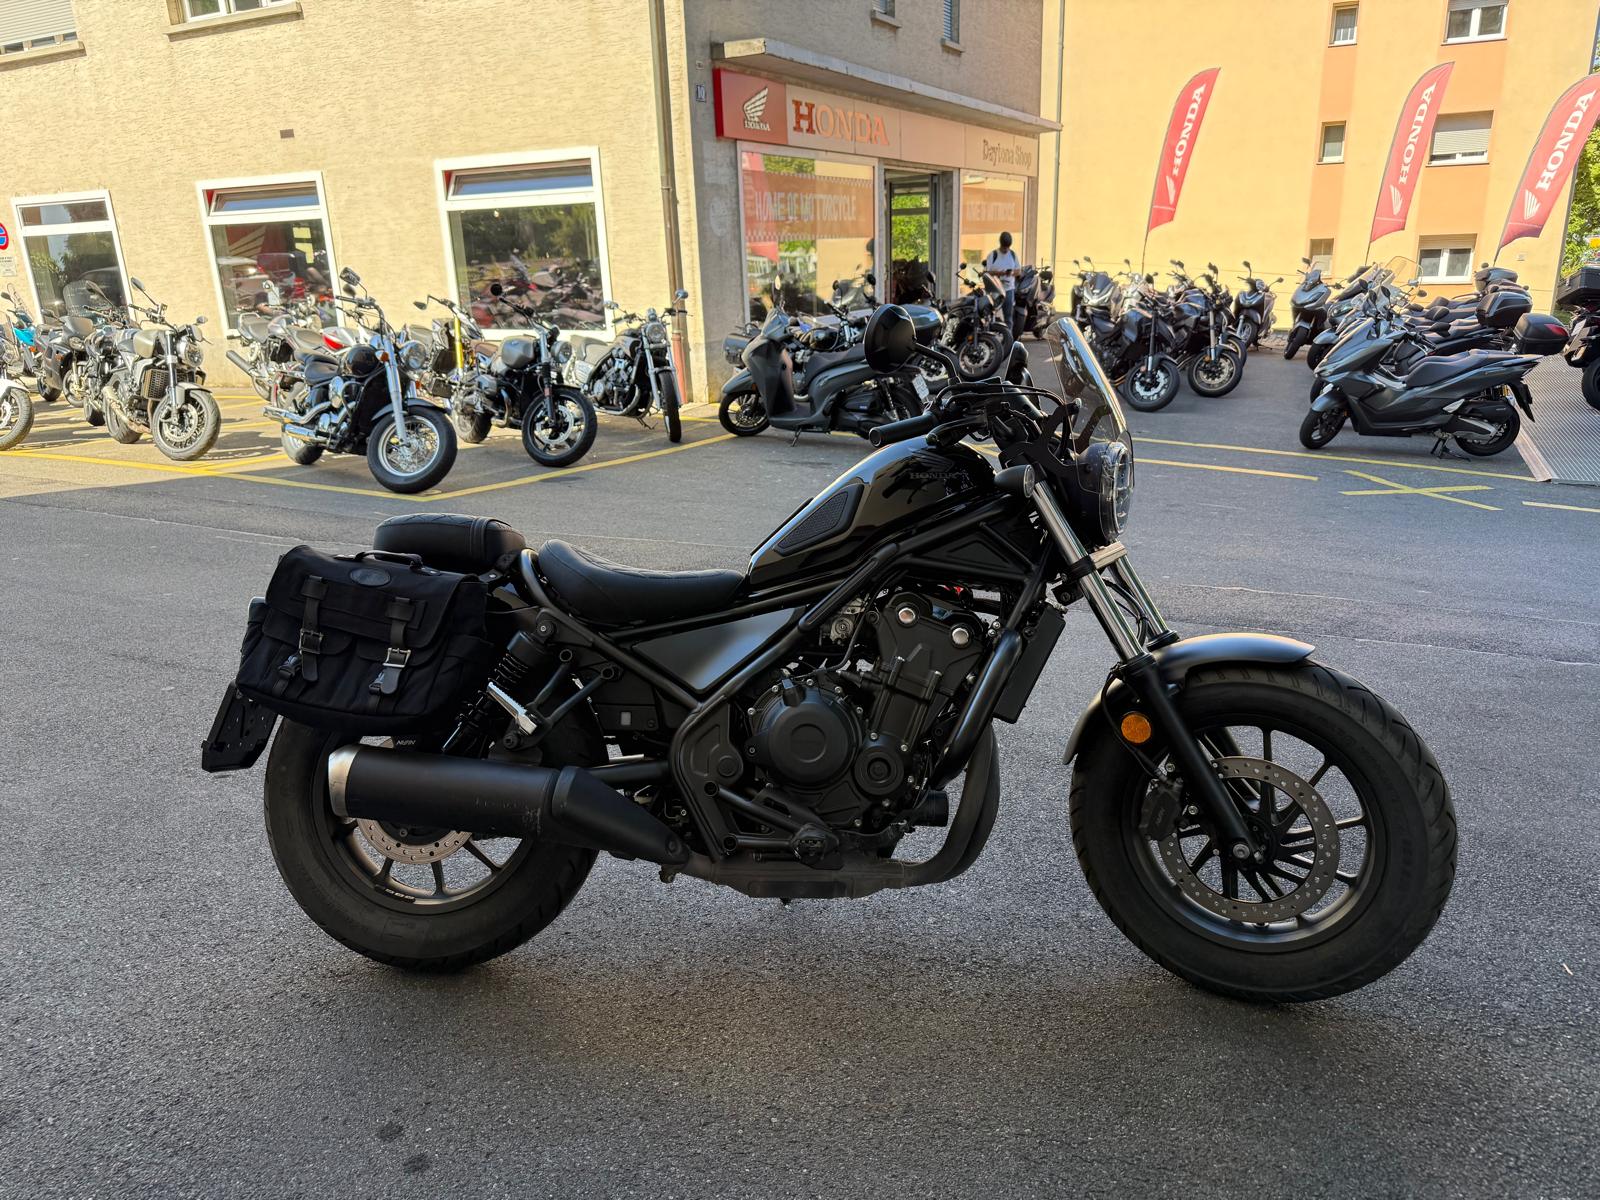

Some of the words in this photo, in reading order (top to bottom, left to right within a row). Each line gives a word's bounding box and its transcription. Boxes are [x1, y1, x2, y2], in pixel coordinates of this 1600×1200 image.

[792, 99, 889, 145] HONDA
[1172, 83, 1206, 176] HONDA
[1399, 82, 1437, 185] HONDA
[1536, 89, 1596, 191] HONDA
